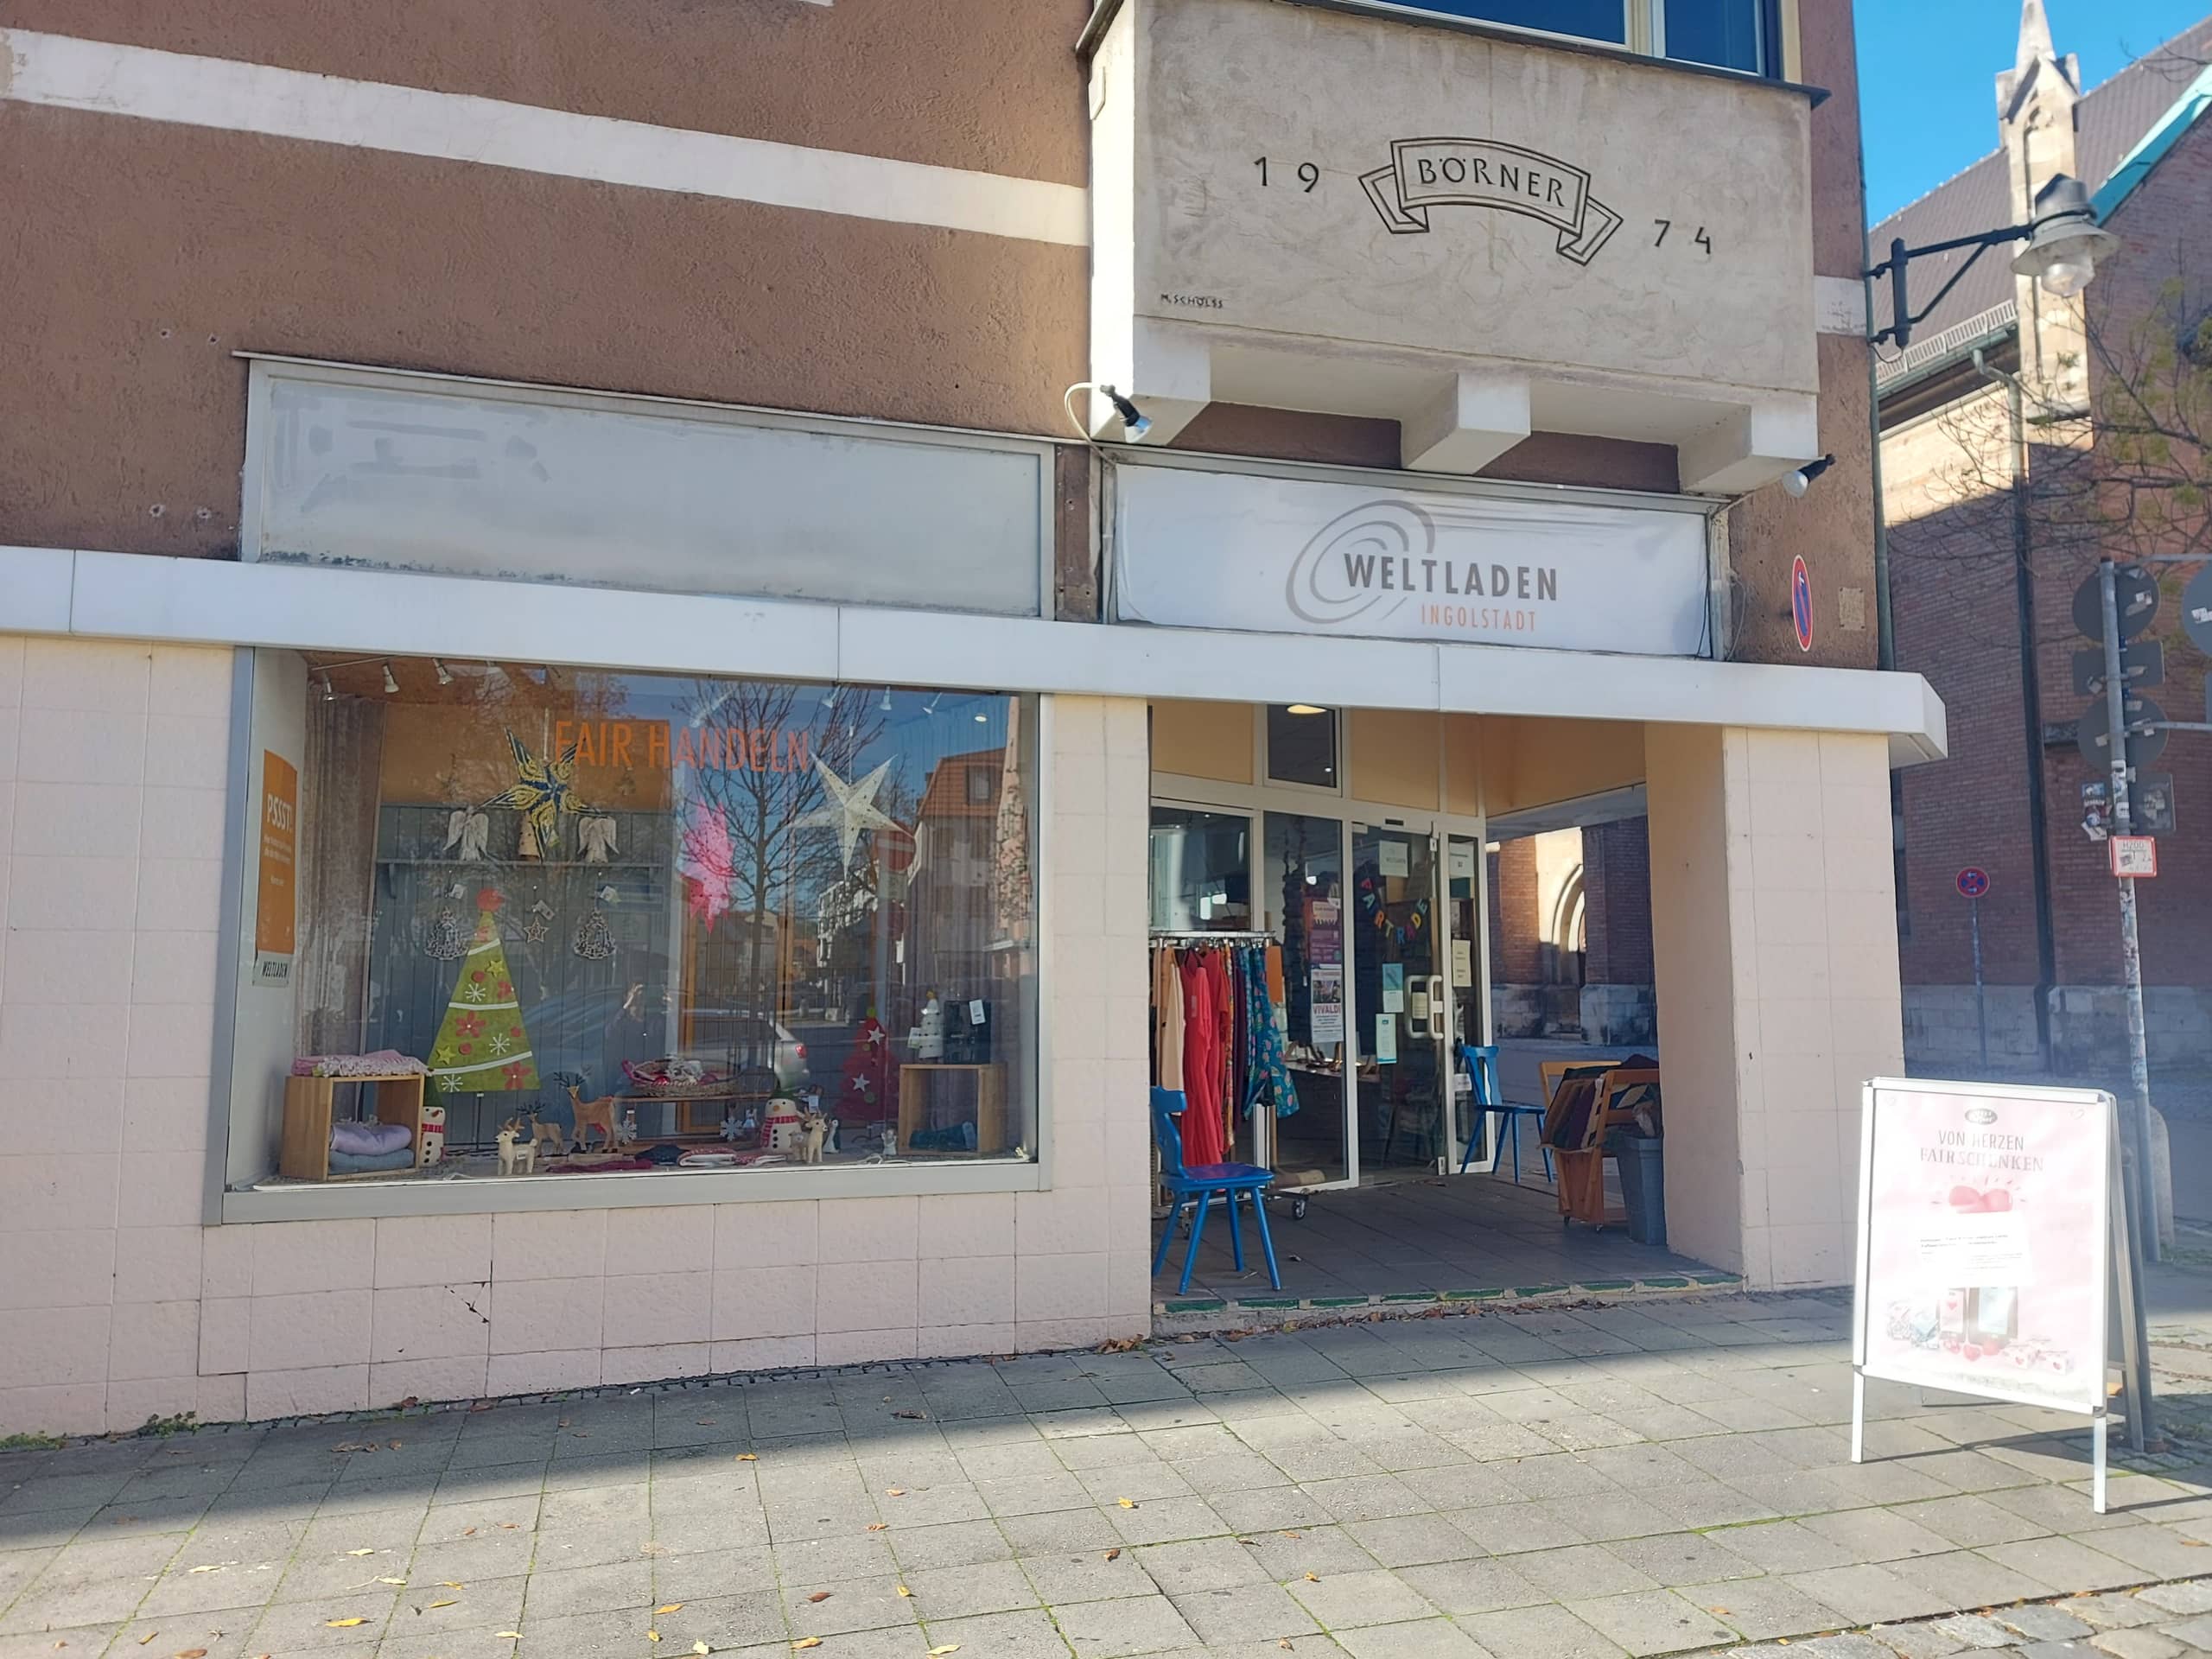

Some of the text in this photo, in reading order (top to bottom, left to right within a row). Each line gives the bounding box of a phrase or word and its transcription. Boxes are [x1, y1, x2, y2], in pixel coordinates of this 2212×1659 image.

[1418, 157, 1565, 207] BÖRNER
[1344, 553, 1556, 601] WELTLADEN
[1421, 605, 1535, 632] INGOLSTADT
[555, 720, 809, 772] FAIR HANDELN
[1938, 1129, 2024, 1151] VON HERZEN
